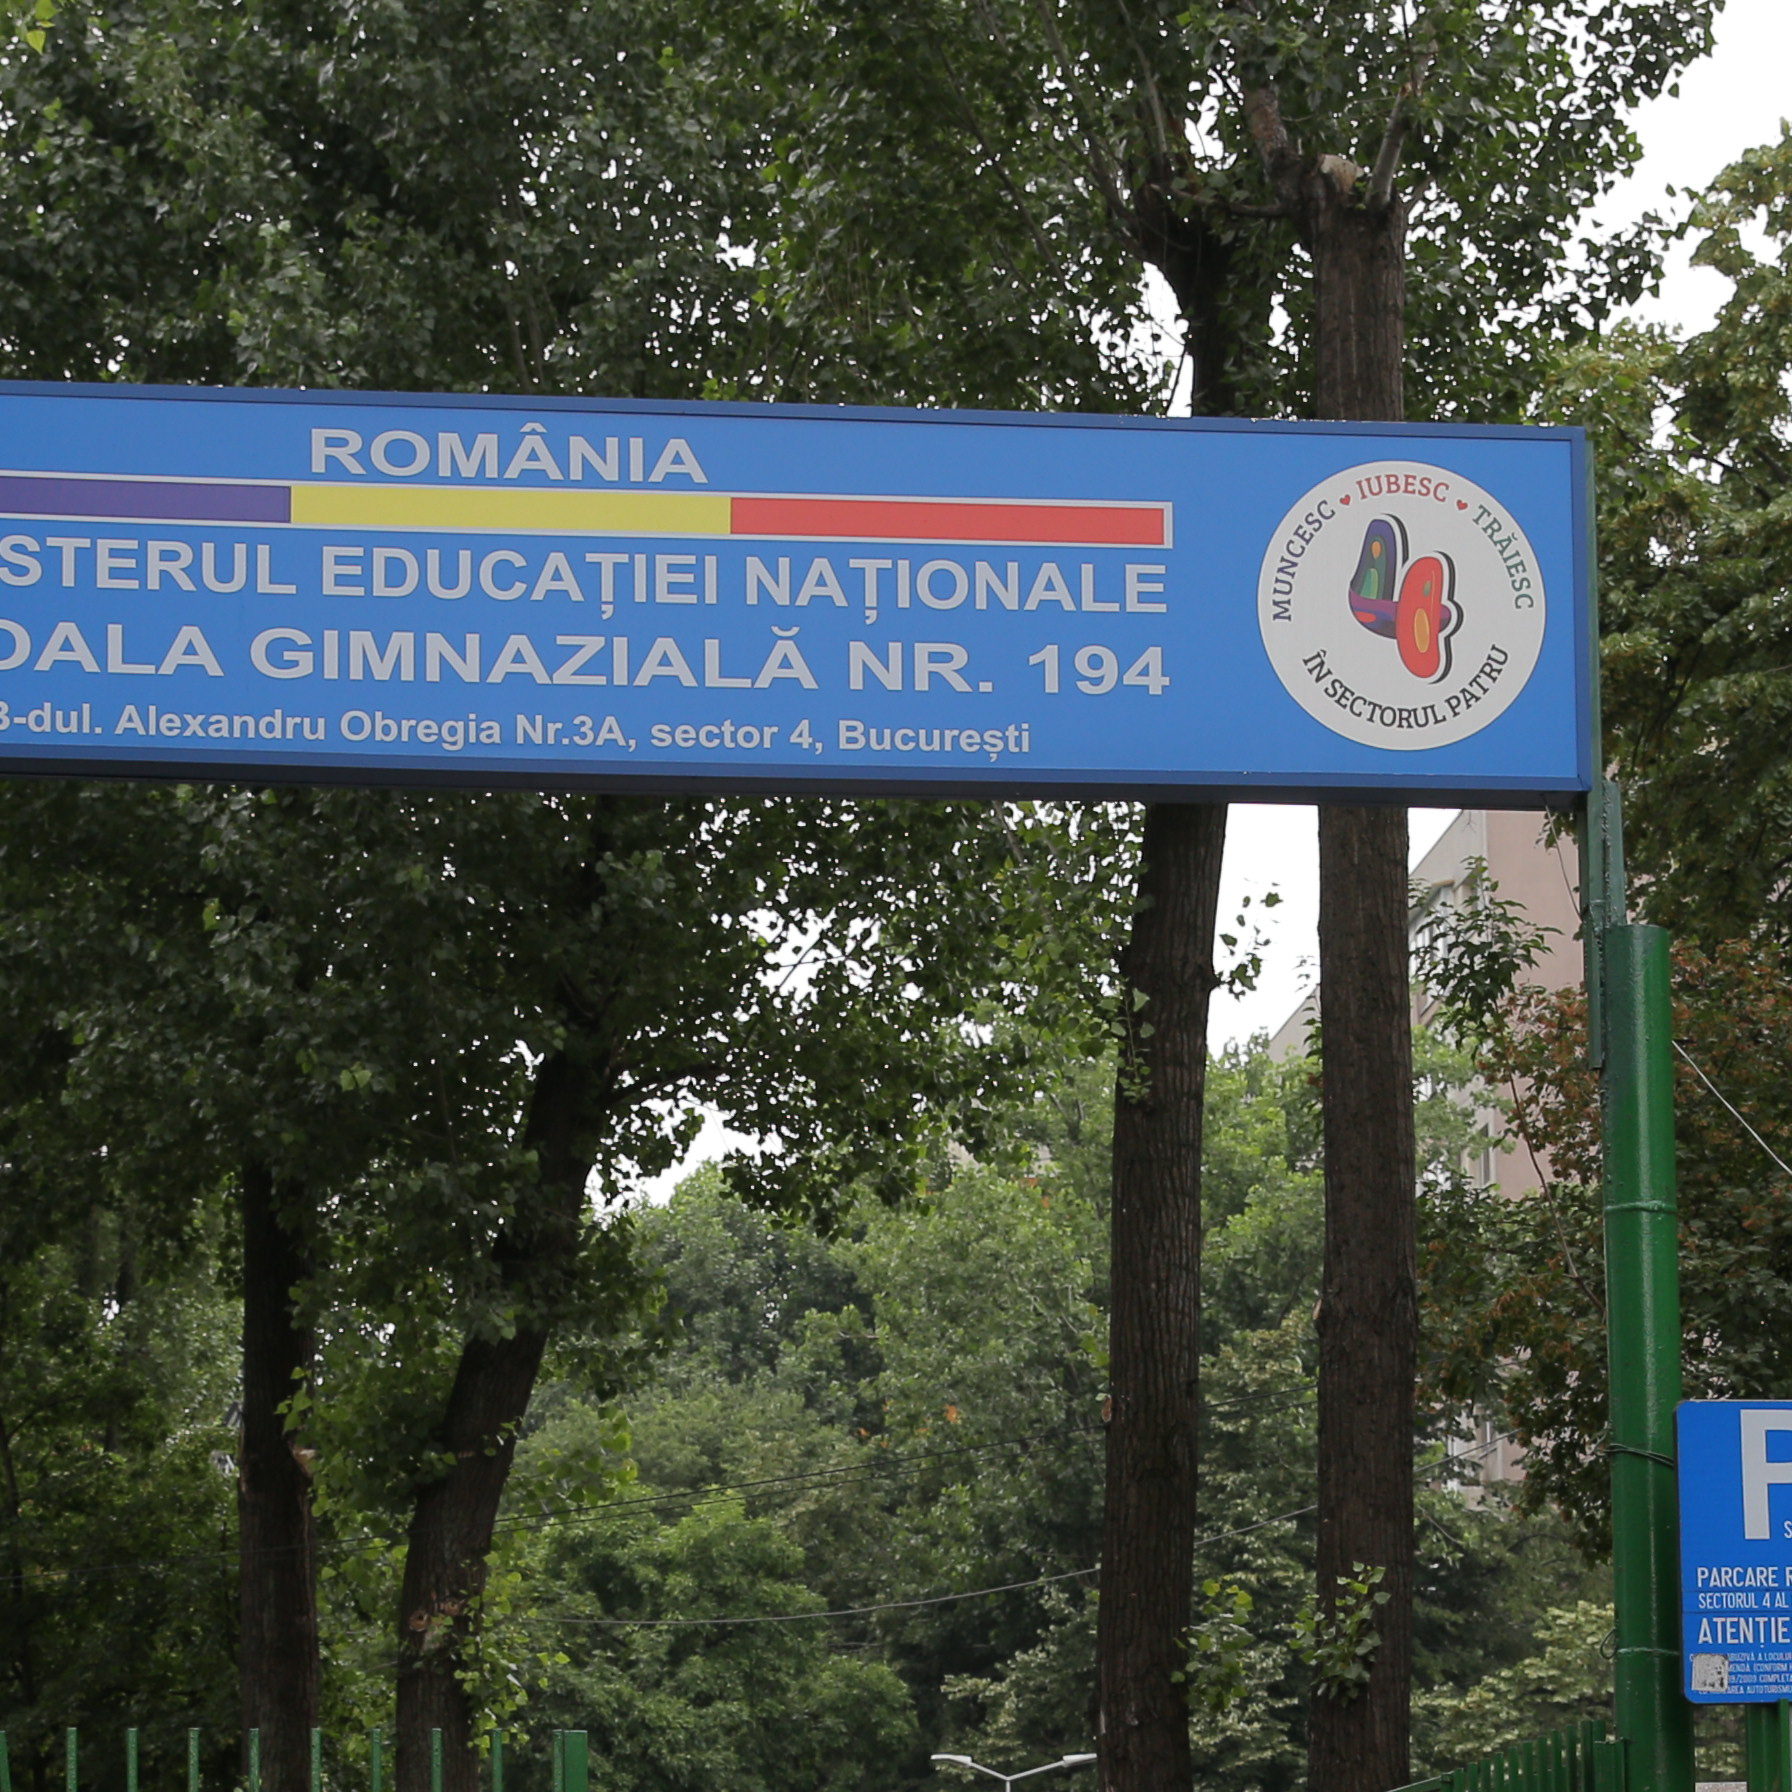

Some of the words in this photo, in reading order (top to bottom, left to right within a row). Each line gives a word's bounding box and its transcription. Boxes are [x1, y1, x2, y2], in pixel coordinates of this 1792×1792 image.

[310, 421, 709, 484] ROMÂNIA
[1272, 499, 1336, 622] MUNCESC
[1355, 473, 1450, 502] IUBESC
[1471, 504, 1535, 610] TRĂIESC
[321, 545, 718, 621] EDUCAȚIEI
[745, 555, 1168, 626] NAȚIONALE
[249, 625, 820, 690] GIMNAZIALĂ
[848, 640, 994, 693] NR.
[1028, 643, 1171, 696] 194
[1302, 648, 1331, 684] ÎN
[1323, 677, 1447, 729] SECTORUL
[1444, 643, 1510, 719] PATRU
[113, 704, 327, 741] Alexandru
[339, 709, 502, 752] Obregia
[515, 713, 638, 752] Nr.3A,
[649, 718, 779, 749] sector
[789, 718, 823, 755] 4,
[837, 719, 1031, 763] București
[1696, 1566, 1779, 1588] PARCARE
[1698, 1592, 1759, 1609] SECTORUL
[1762, 1591, 1771, 1608] 4
[1774, 1591, 1789, 1608] AL
